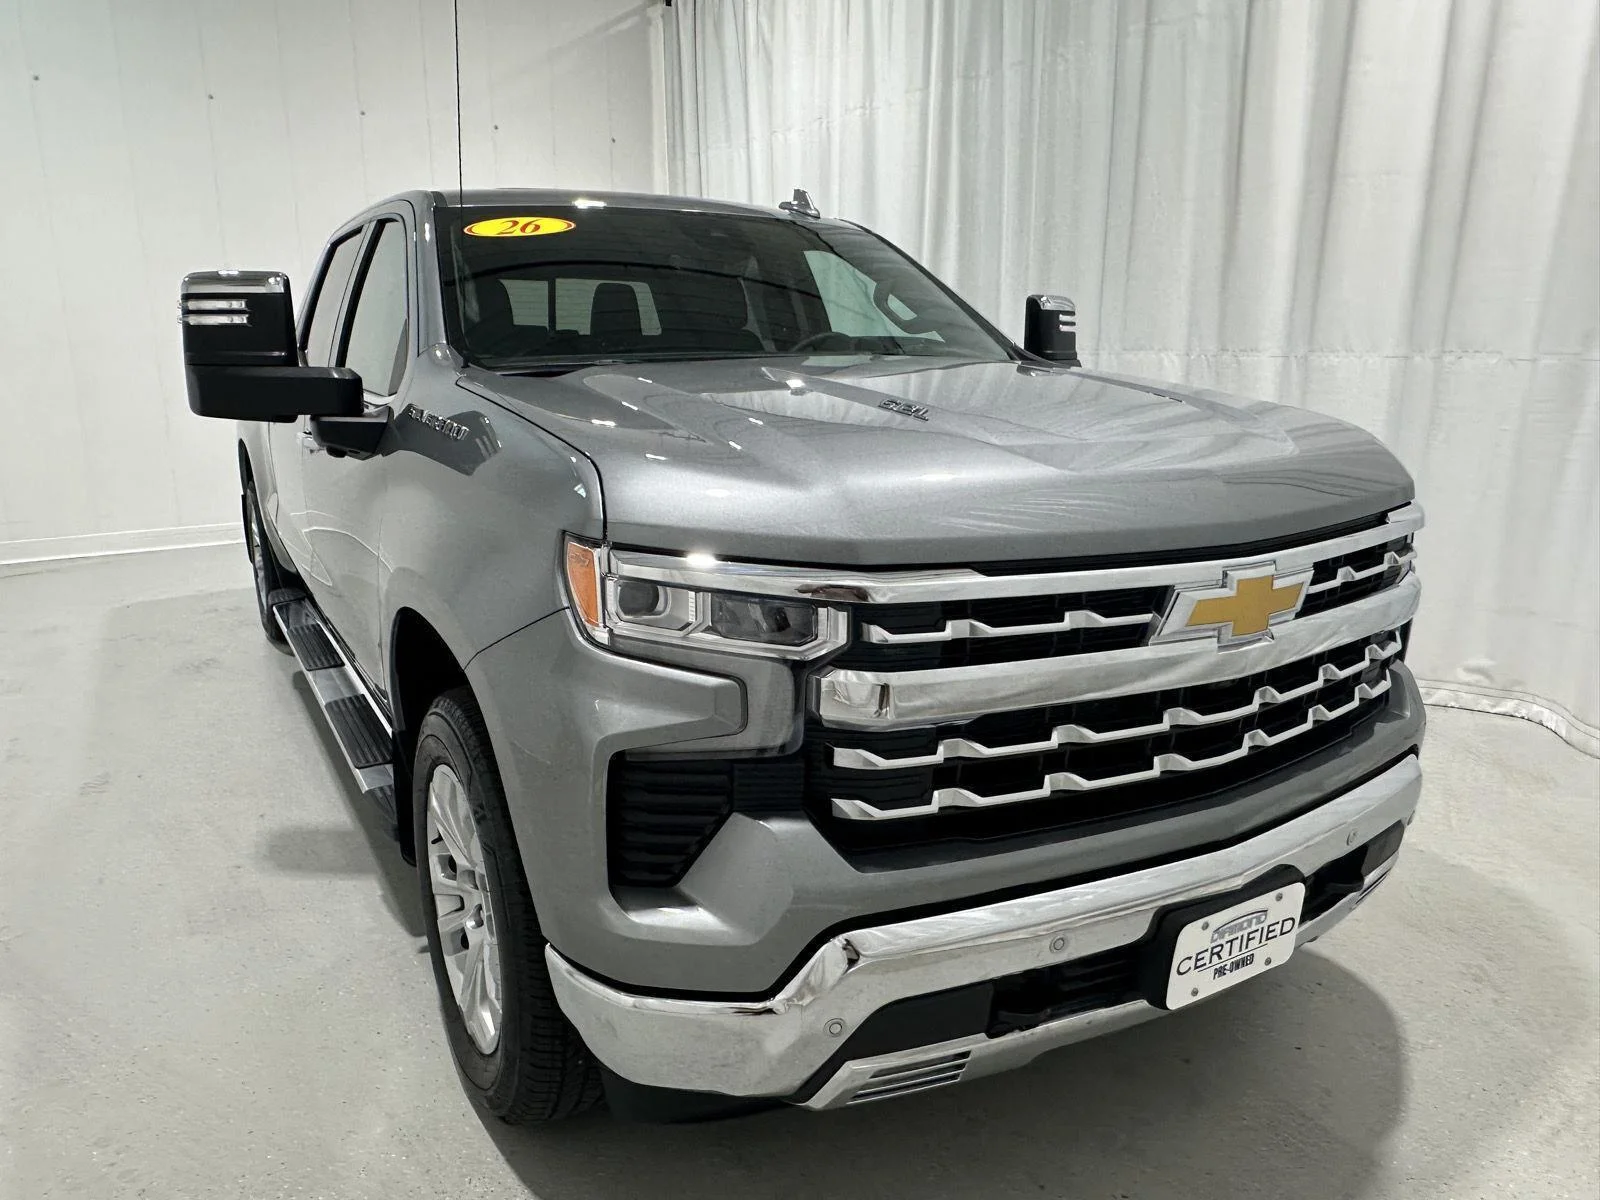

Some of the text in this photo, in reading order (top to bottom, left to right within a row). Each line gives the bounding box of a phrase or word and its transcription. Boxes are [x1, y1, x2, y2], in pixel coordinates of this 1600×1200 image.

[496, 219, 541, 235] 26
[1176, 917, 1296, 976] CERTIFIED
[1212, 953, 1255, 980] PRE-OWNED
